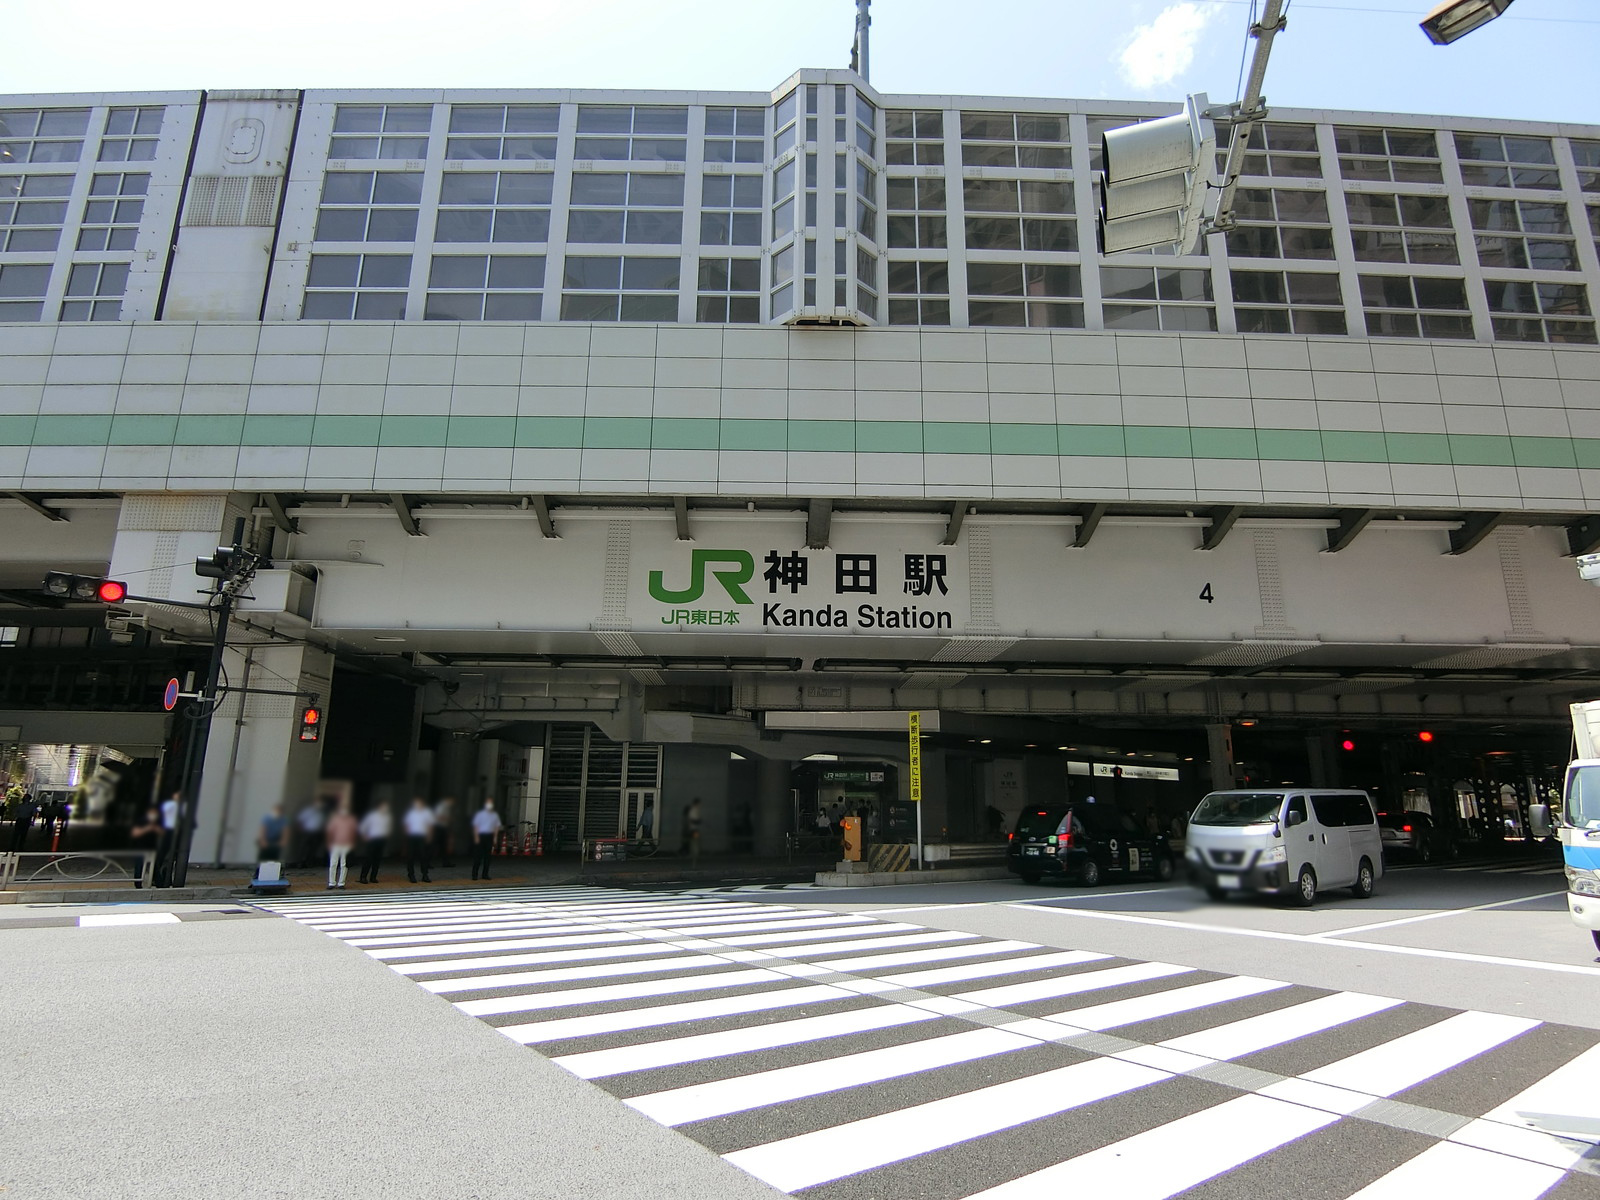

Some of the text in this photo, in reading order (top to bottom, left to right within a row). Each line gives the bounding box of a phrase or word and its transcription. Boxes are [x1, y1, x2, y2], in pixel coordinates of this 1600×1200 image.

[648, 549, 755, 605] JR
[763, 550, 949, 597] 神田駅
[1199, 582, 1214, 604] 4
[661, 609, 740, 626] JR東日本
[762, 603, 953, 630] Kanda Station
